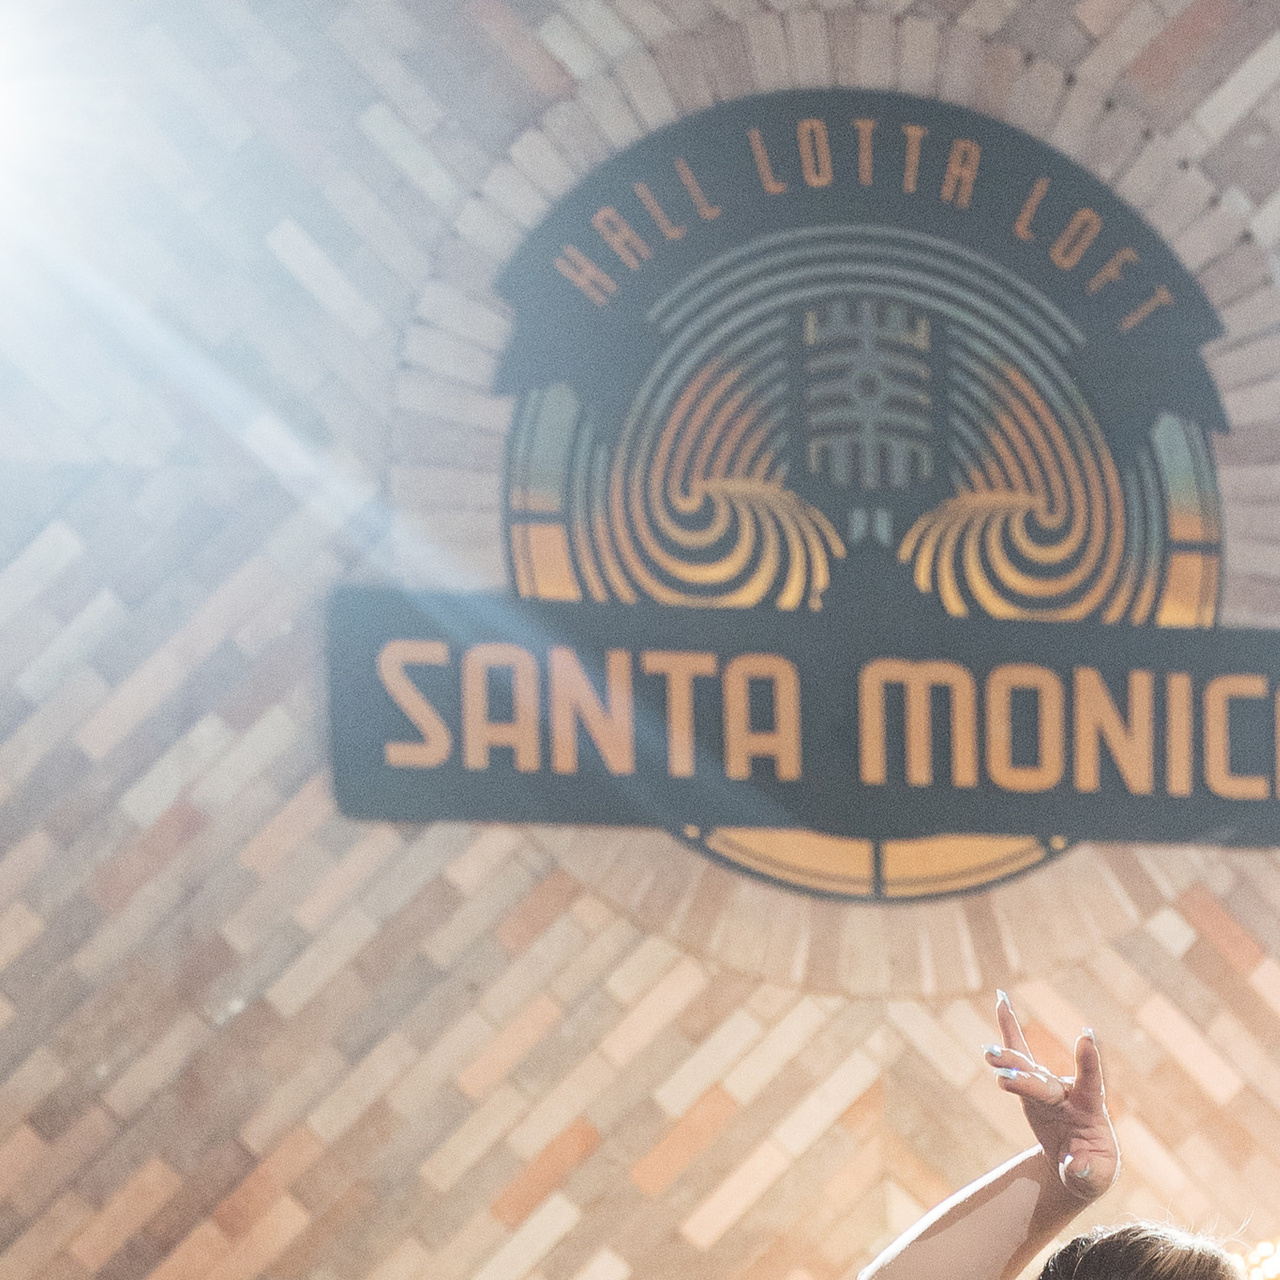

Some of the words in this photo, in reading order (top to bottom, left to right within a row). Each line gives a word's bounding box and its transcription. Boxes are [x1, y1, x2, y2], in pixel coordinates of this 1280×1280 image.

[555, 158, 722, 306] HALL
[748, 117, 984, 208] LOTTA
[1013, 177, 1175, 333] LOFT
[376, 638, 802, 782] SANTA
